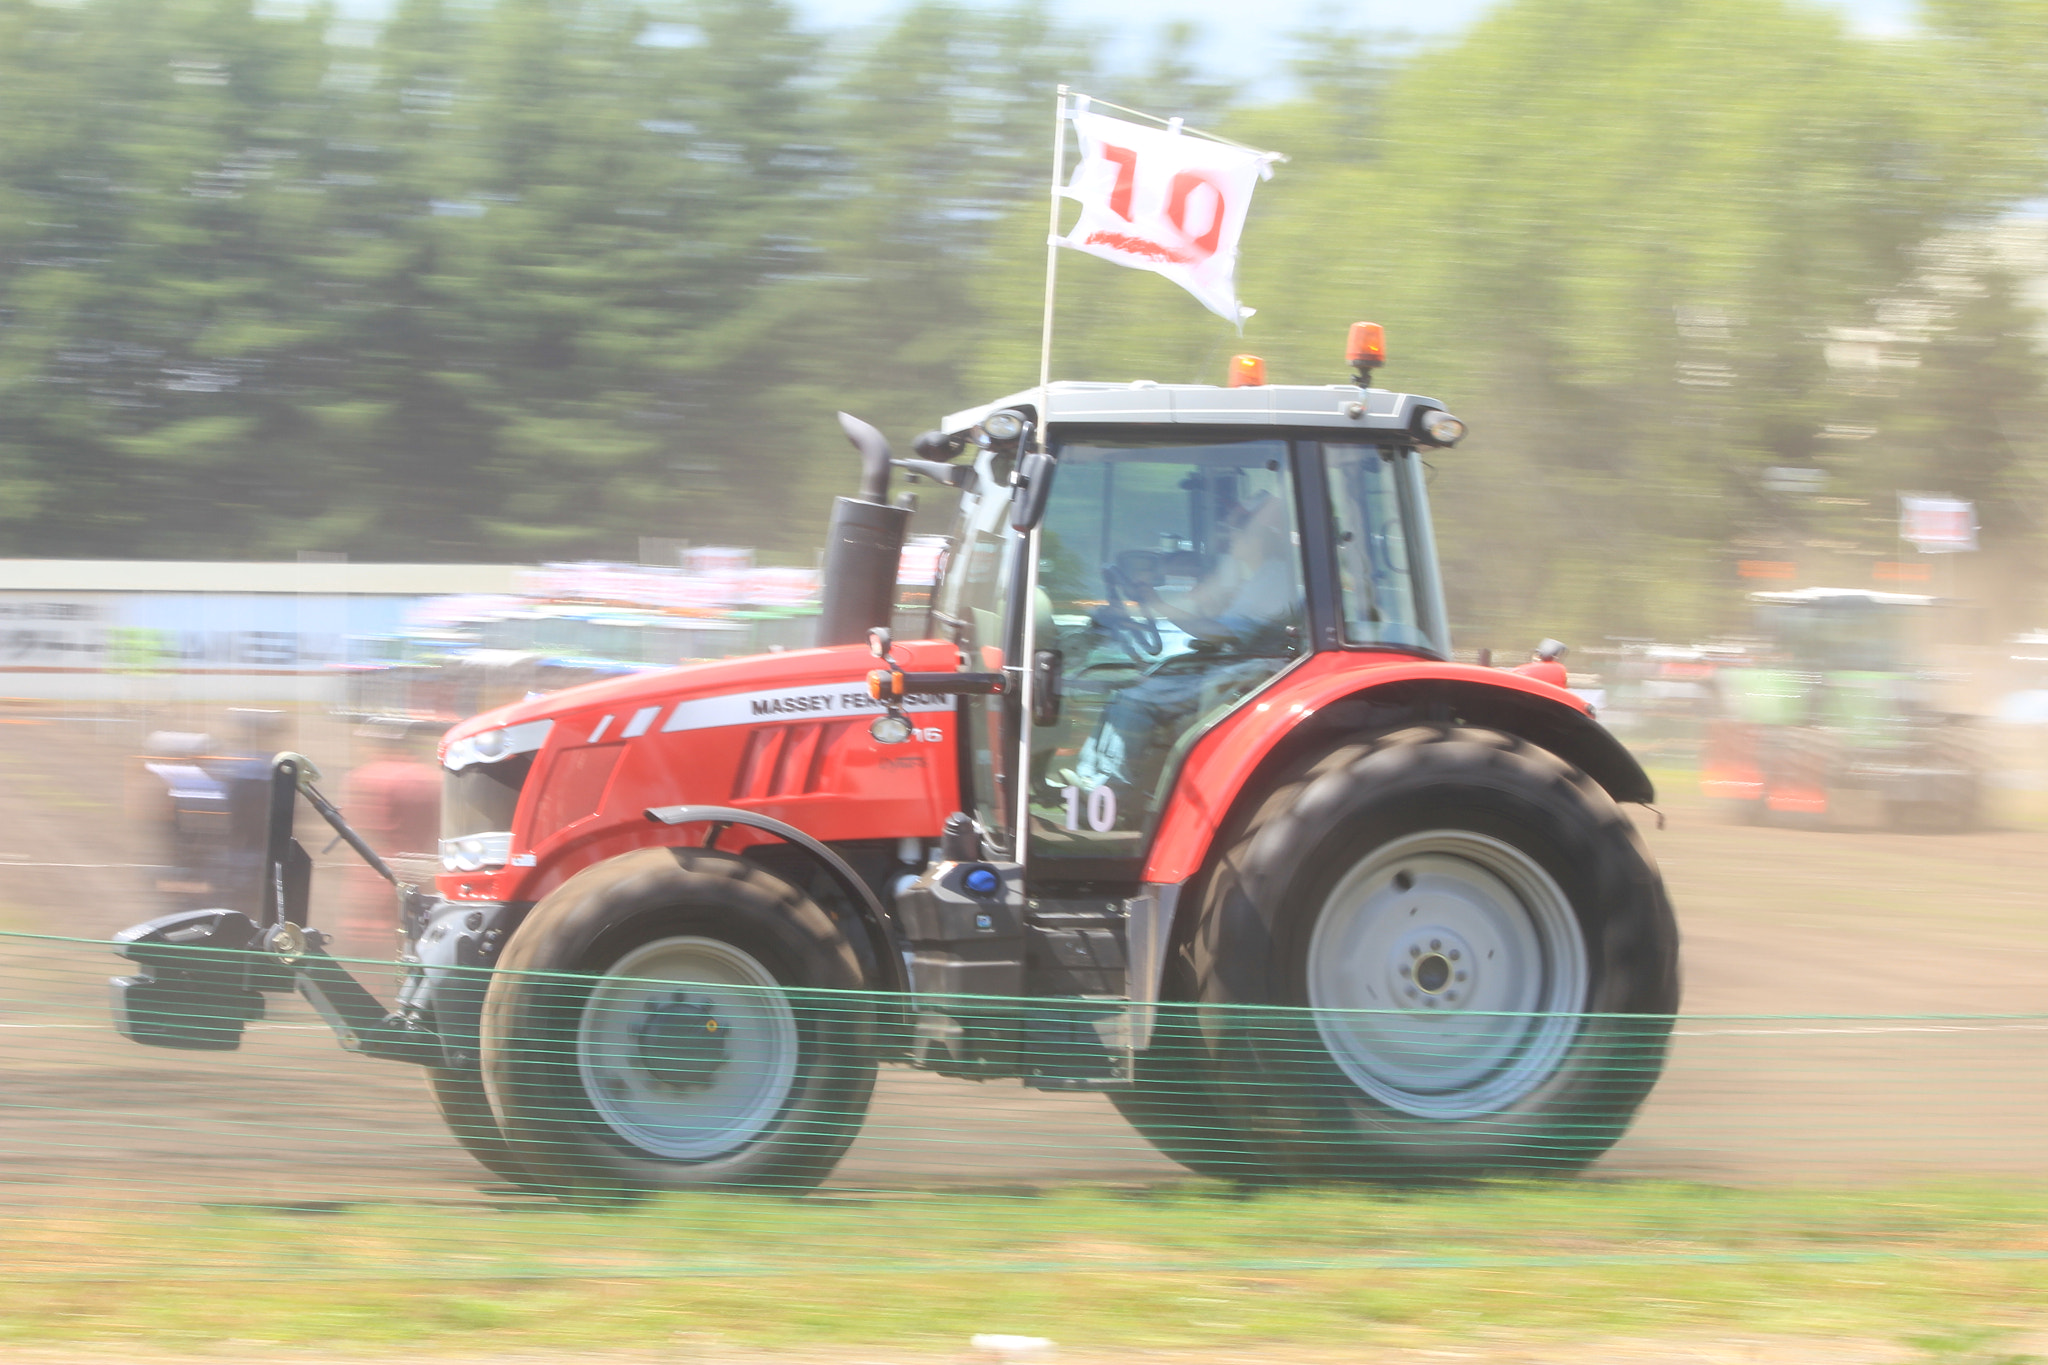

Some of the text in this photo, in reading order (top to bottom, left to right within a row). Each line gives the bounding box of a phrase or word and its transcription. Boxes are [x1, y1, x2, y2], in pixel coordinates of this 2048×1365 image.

[1100, 140, 1226, 259] 10
[752, 691, 947, 716] MASSEY FERSON
[911, 727, 944, 743] 16
[1061, 785, 1117, 832] 10
